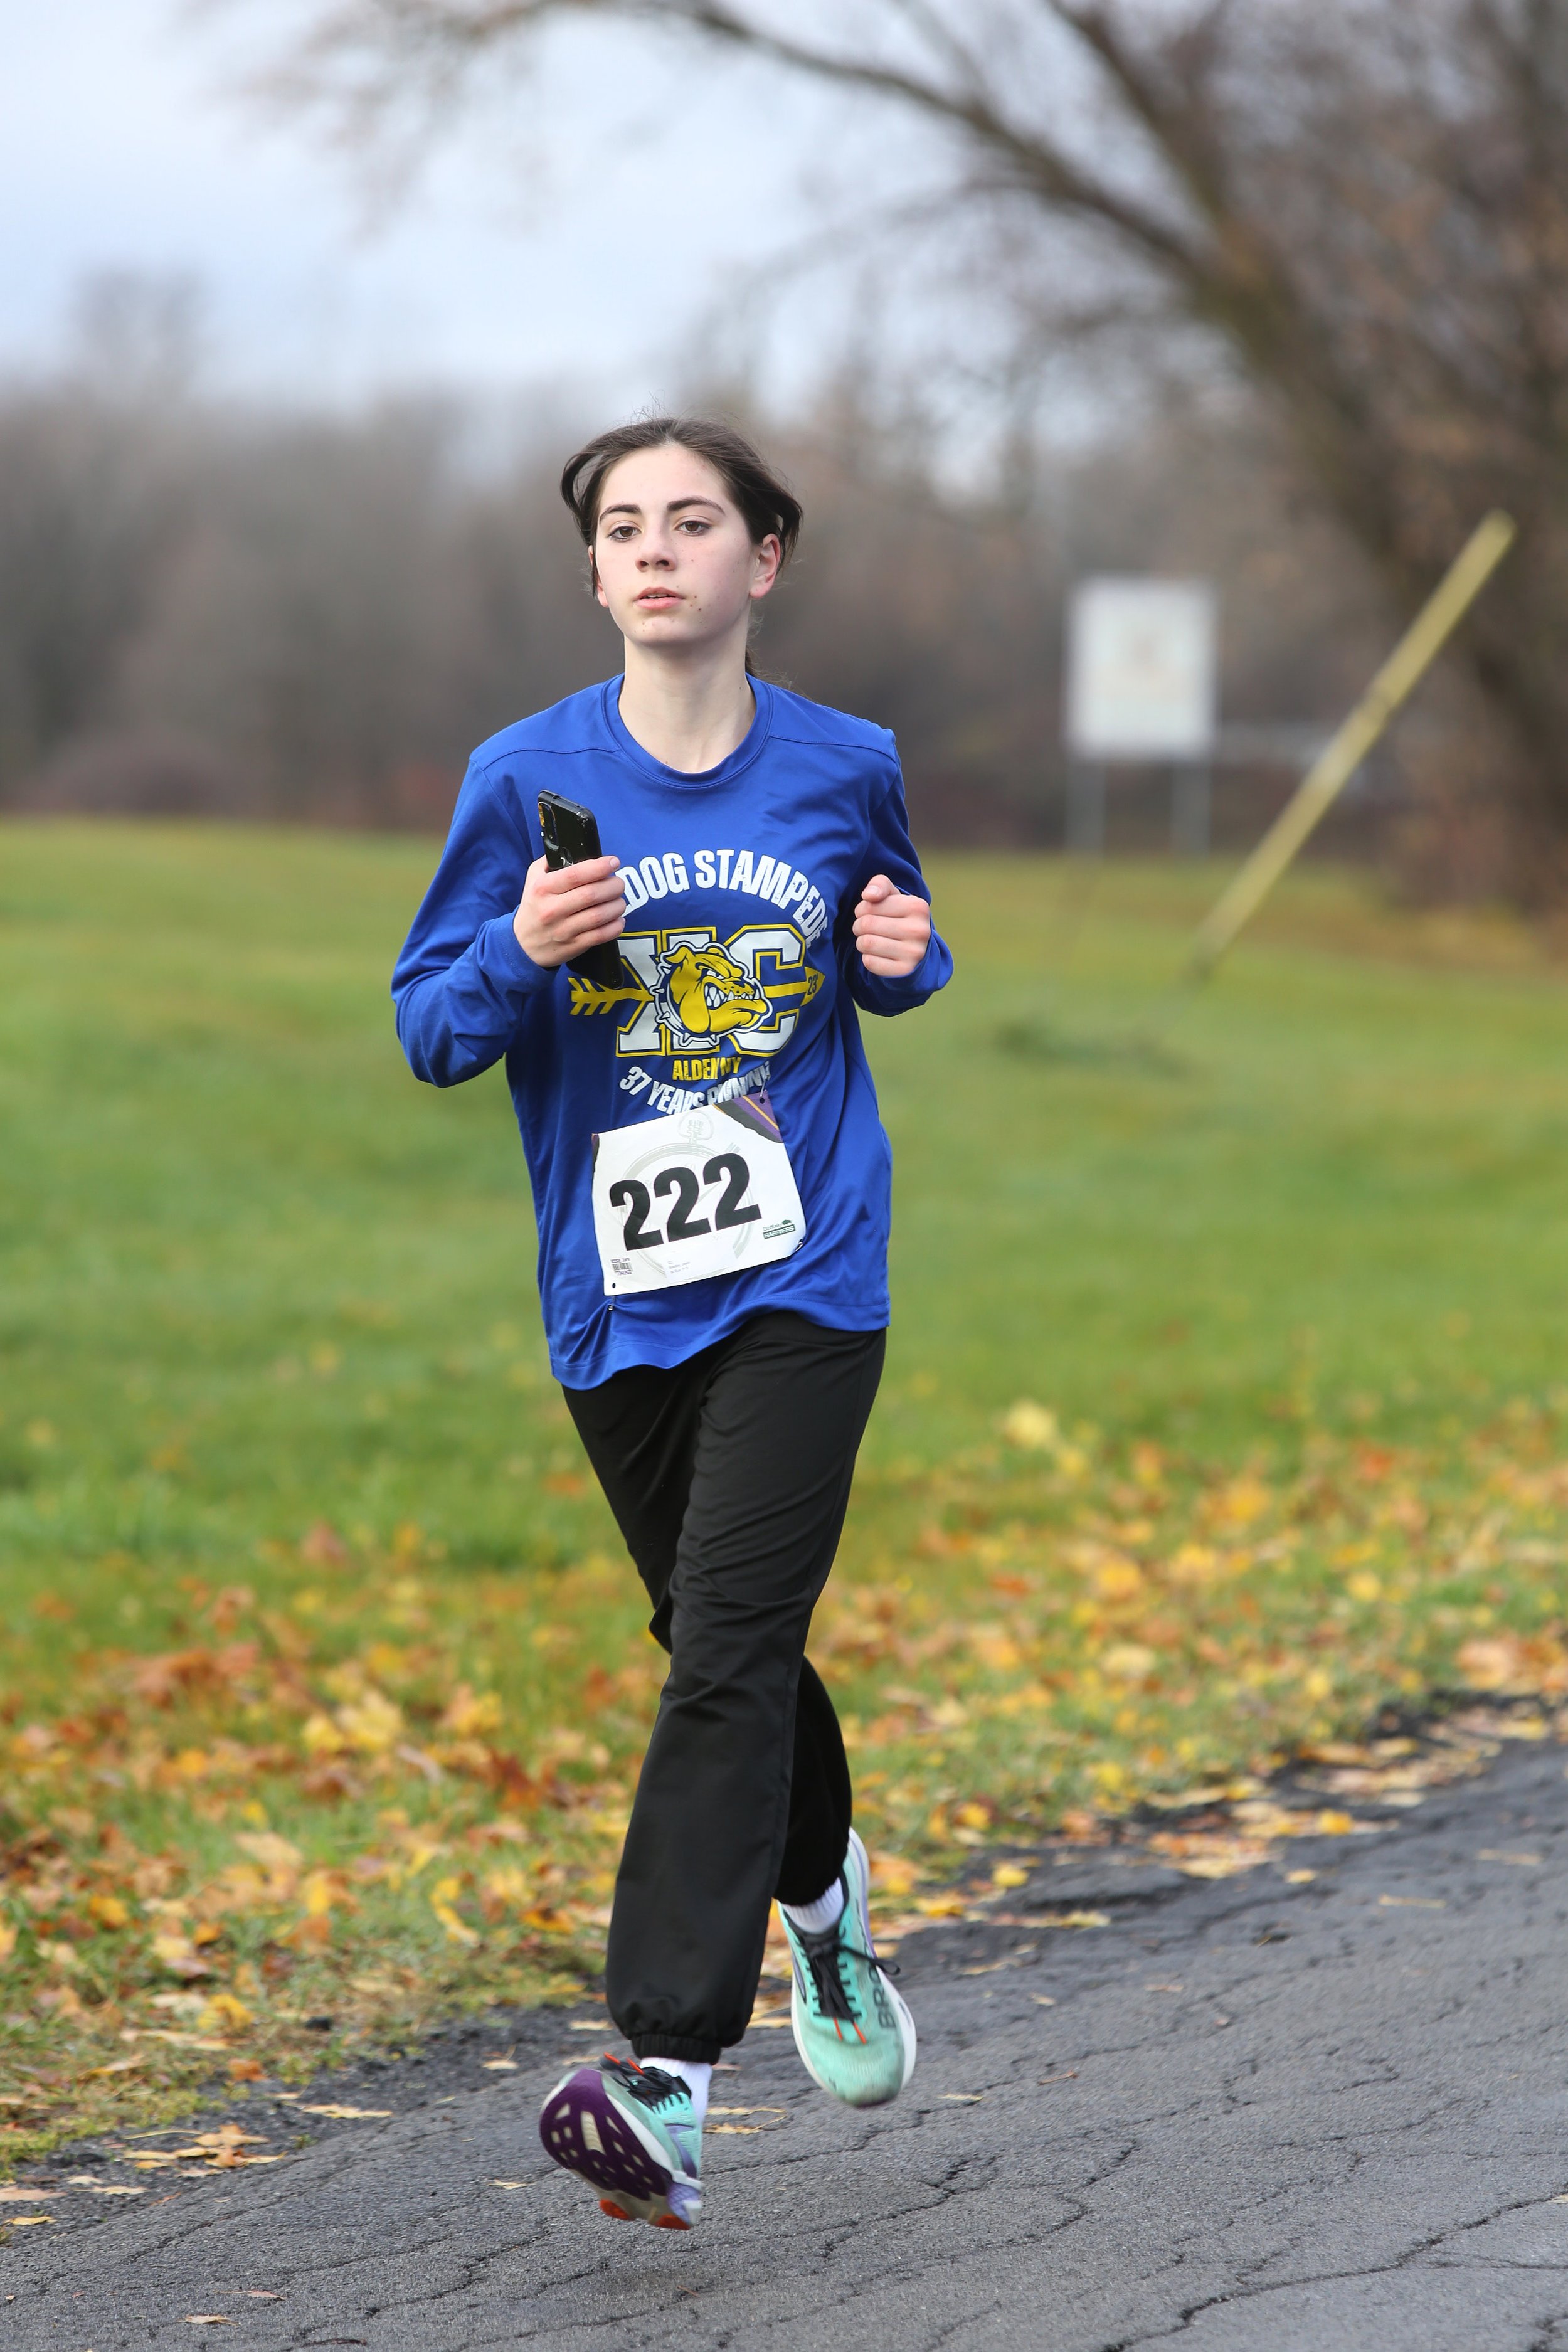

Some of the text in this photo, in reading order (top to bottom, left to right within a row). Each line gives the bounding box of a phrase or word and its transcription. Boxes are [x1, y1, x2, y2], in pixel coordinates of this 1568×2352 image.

[614, 852, 691, 918] DOG
[619, 1066, 653, 1096] 37
[609, 1153, 762, 1251] 222
